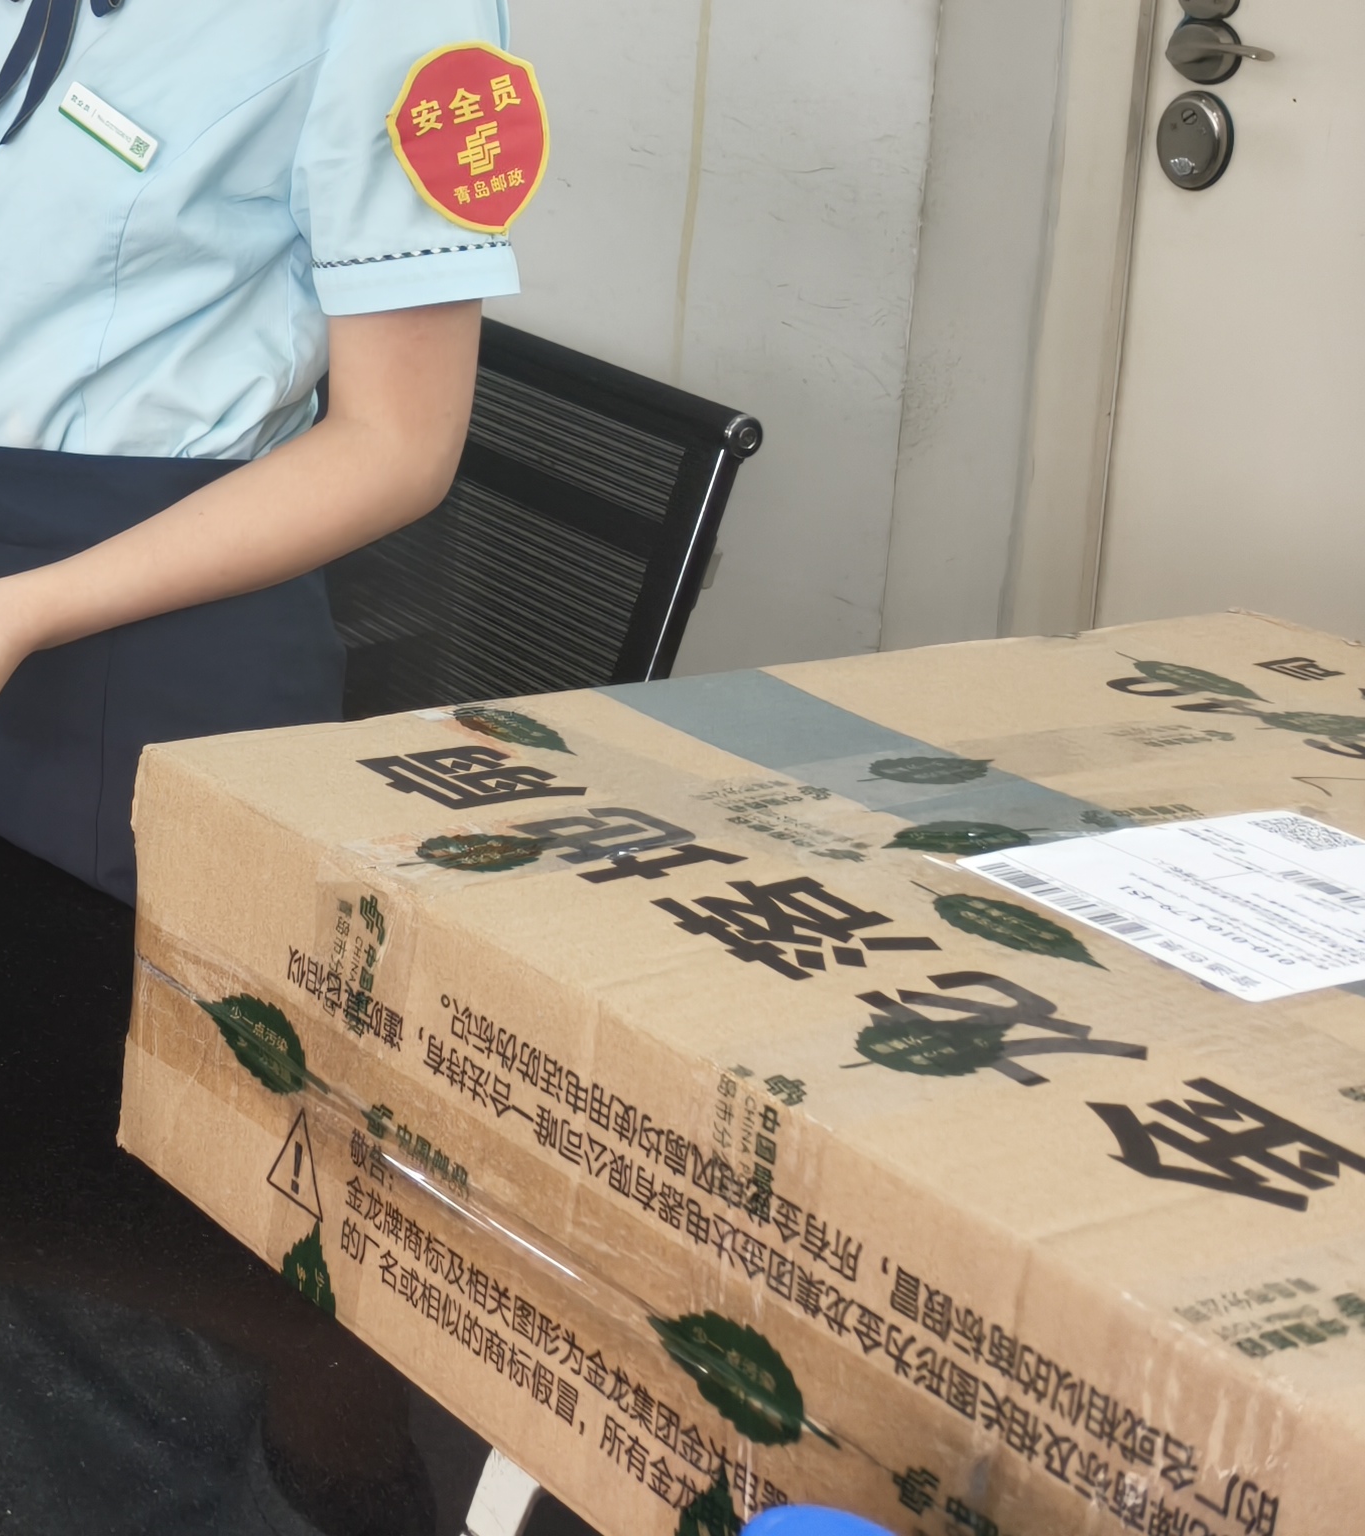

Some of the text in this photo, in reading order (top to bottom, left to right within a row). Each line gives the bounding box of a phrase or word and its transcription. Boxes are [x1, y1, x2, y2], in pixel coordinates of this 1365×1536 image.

[410, 73, 522, 137] 安全员
[453, 167, 526, 205] 青岛邮政
